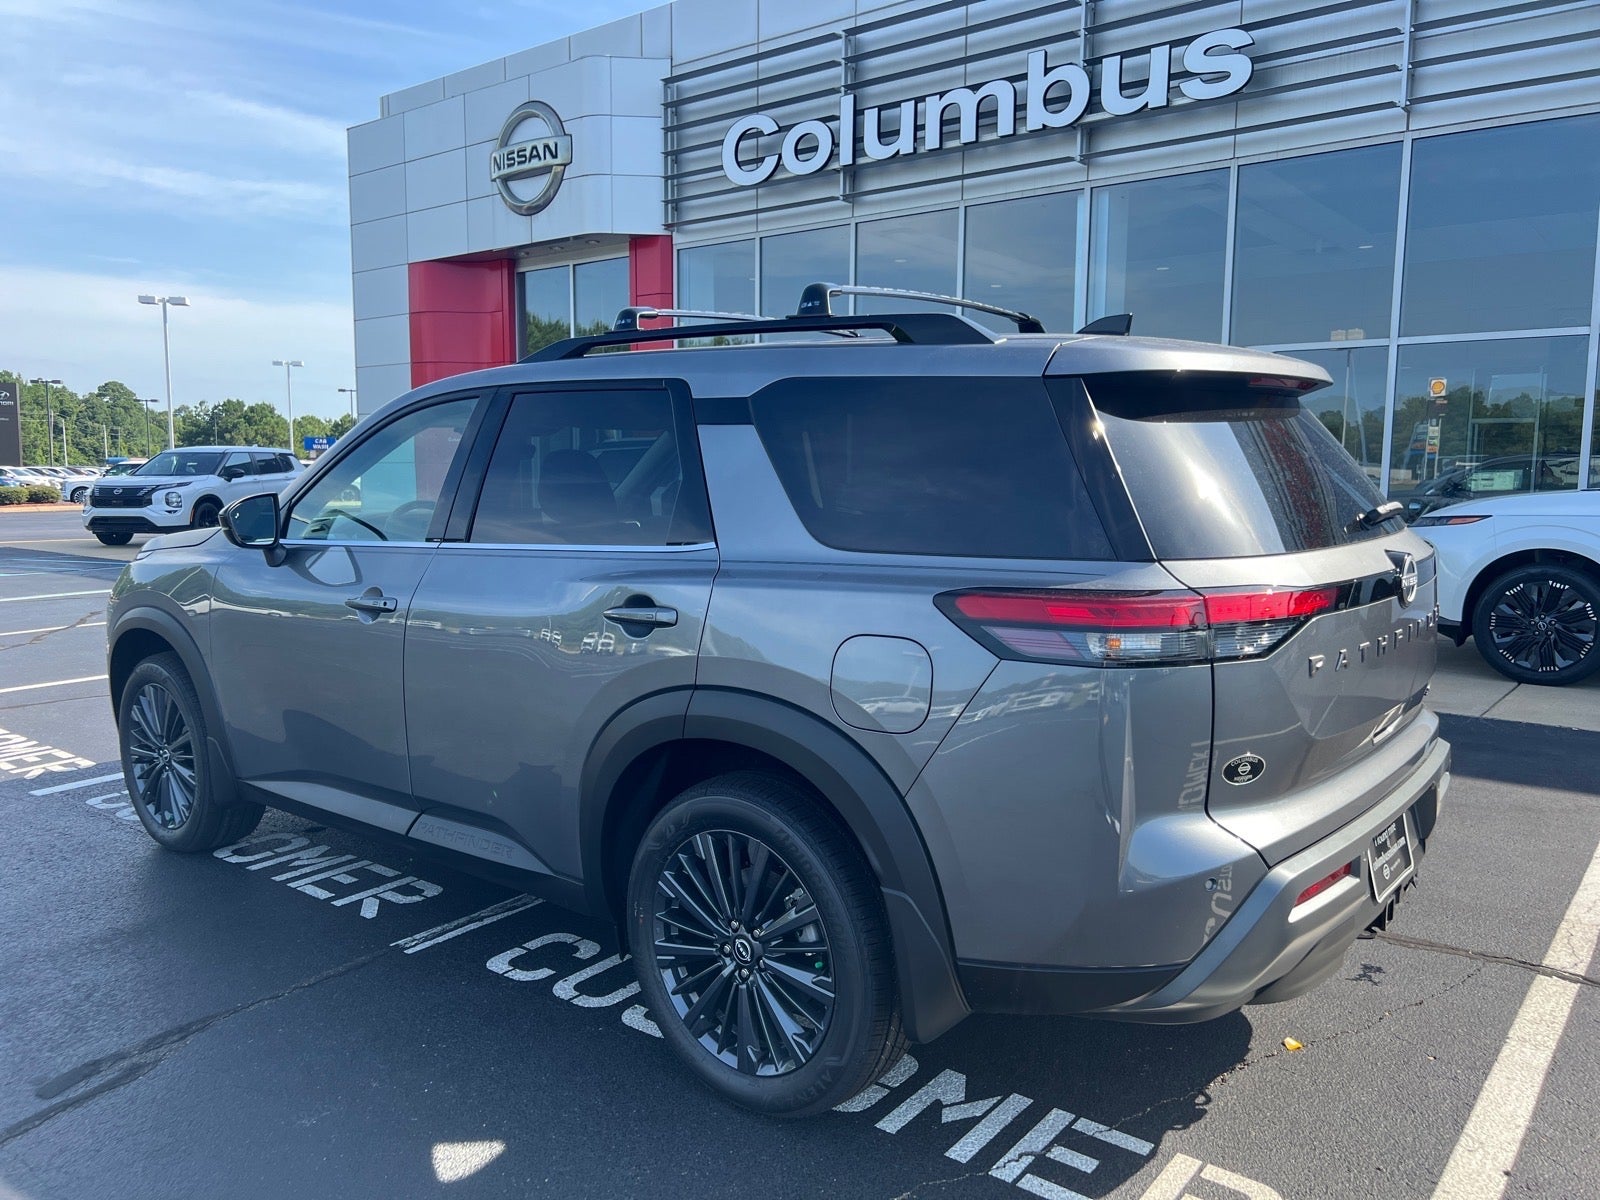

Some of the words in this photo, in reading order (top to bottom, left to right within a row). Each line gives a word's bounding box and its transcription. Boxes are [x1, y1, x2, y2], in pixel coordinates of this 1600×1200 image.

[720, 27, 1255, 186] Columbus
[492, 141, 558, 173] NISSAN
[416, 820, 517, 859] PATHFINDER
